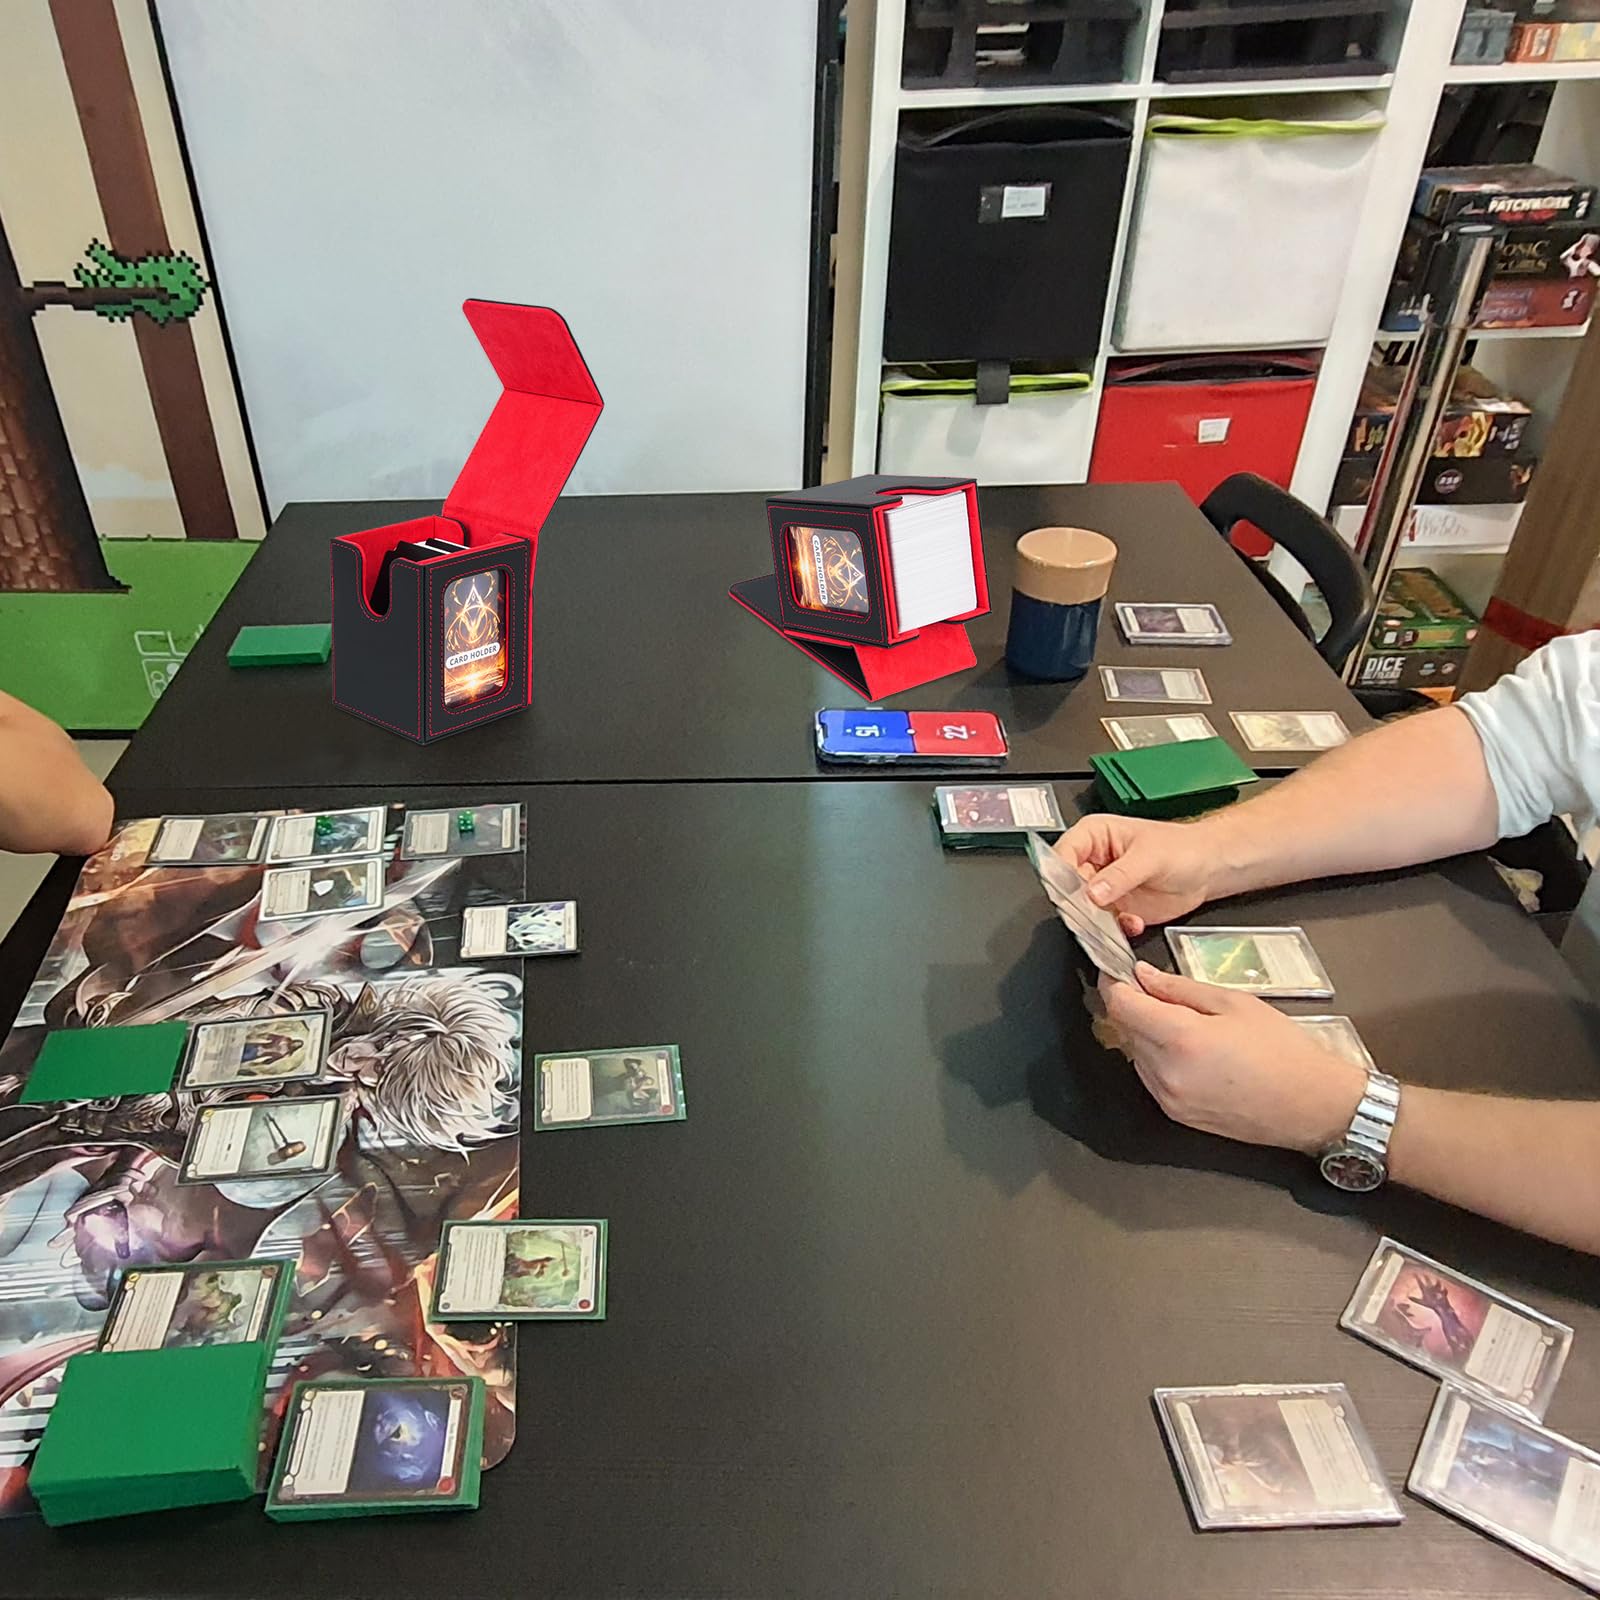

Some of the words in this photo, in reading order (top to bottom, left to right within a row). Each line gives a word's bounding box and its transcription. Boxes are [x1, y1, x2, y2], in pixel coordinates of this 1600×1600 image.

[813, 540, 821, 563] CARD
[817, 566, 827, 600] HOLDER
[449, 653, 469, 666] CARD
[471, 645, 497, 659] HOLDER
[1365, 656, 1406, 672] DICE
[855, 725, 880, 738] 15
[942, 725, 969, 740] 22
